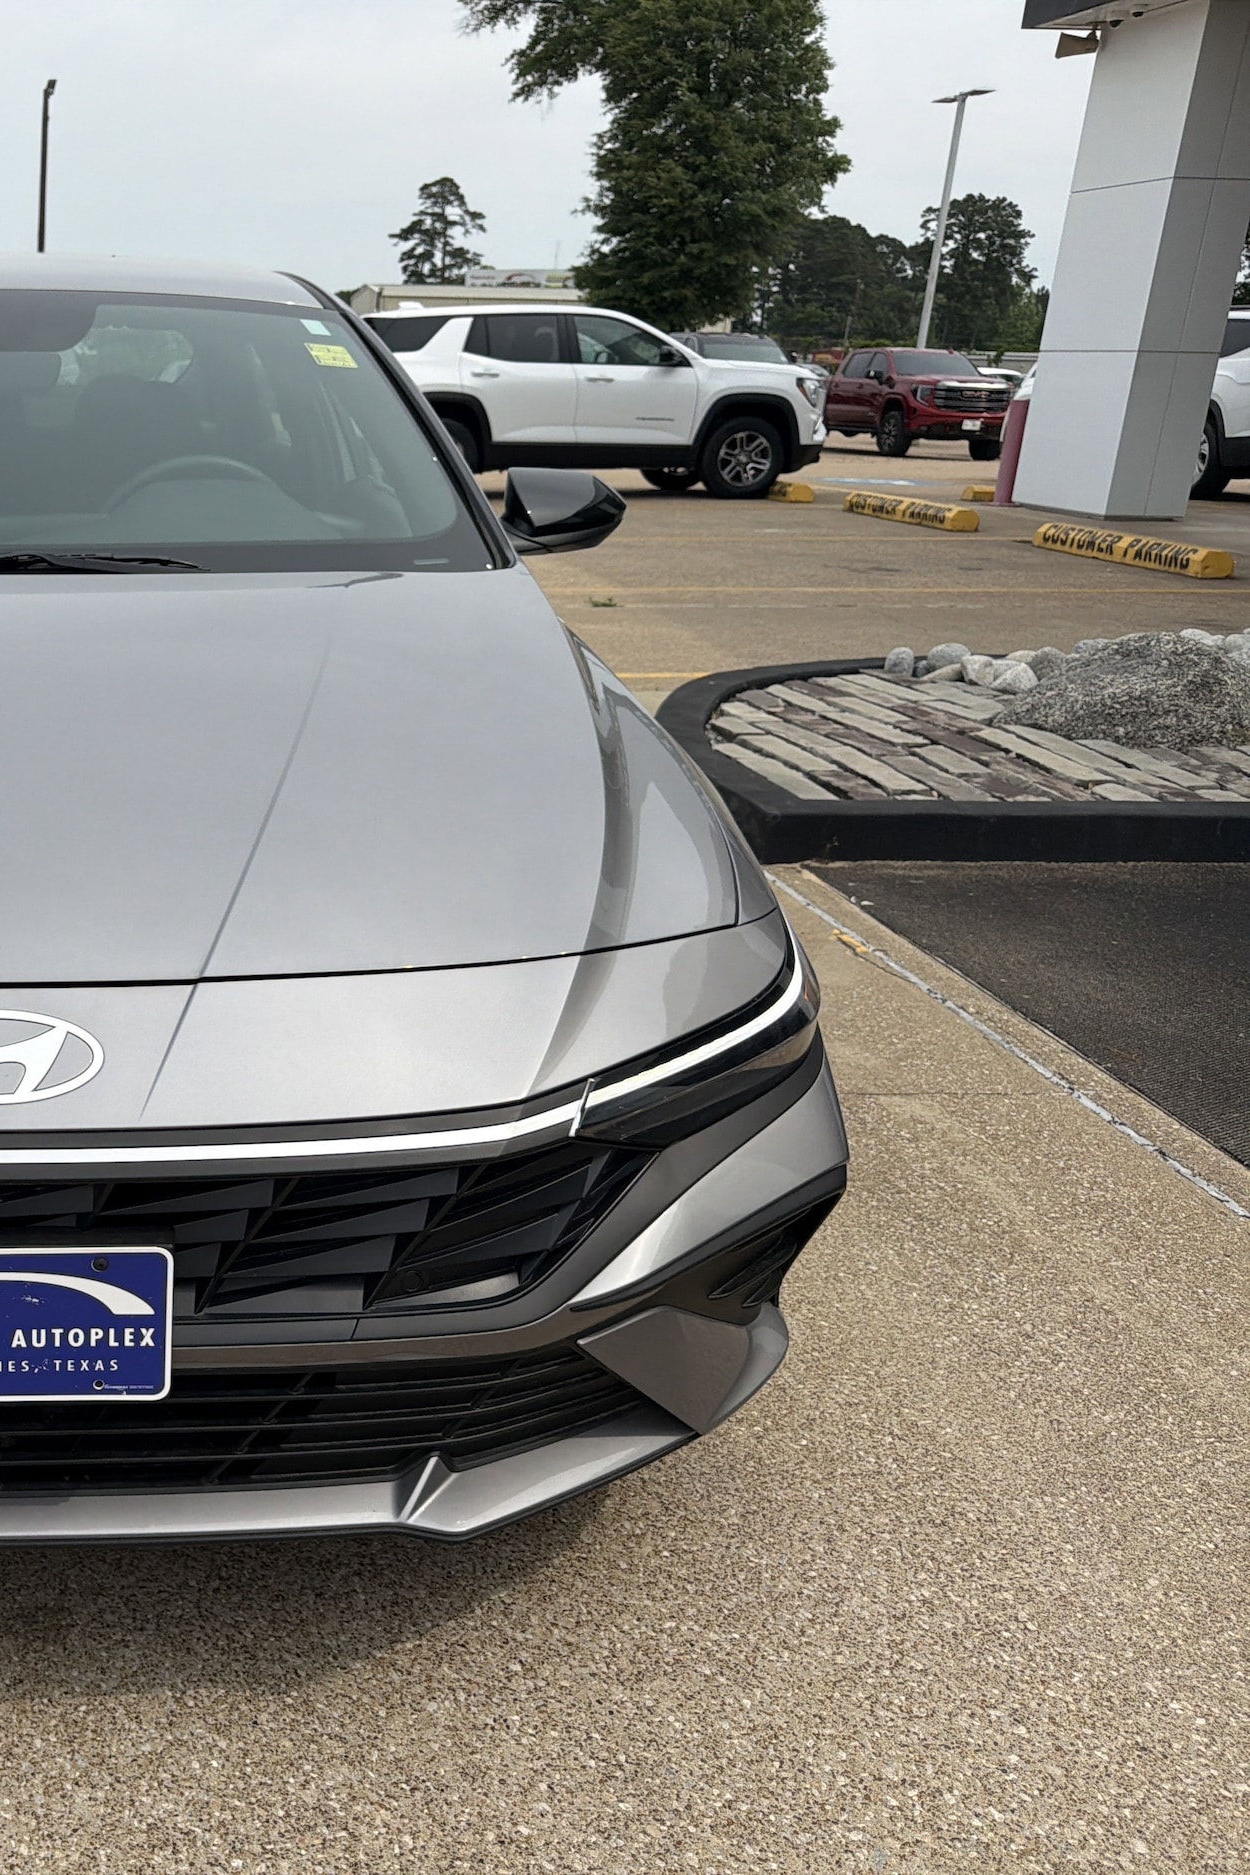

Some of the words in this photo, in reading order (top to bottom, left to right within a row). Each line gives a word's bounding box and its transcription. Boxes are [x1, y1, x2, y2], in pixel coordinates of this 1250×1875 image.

[1042, 524, 1124, 555] CUSTOMER
[1122, 538, 1199, 570] PARKING
[11, 1327, 156, 1349] AUTOPLEX
[53, 1359, 120, 1373] TEXAS
